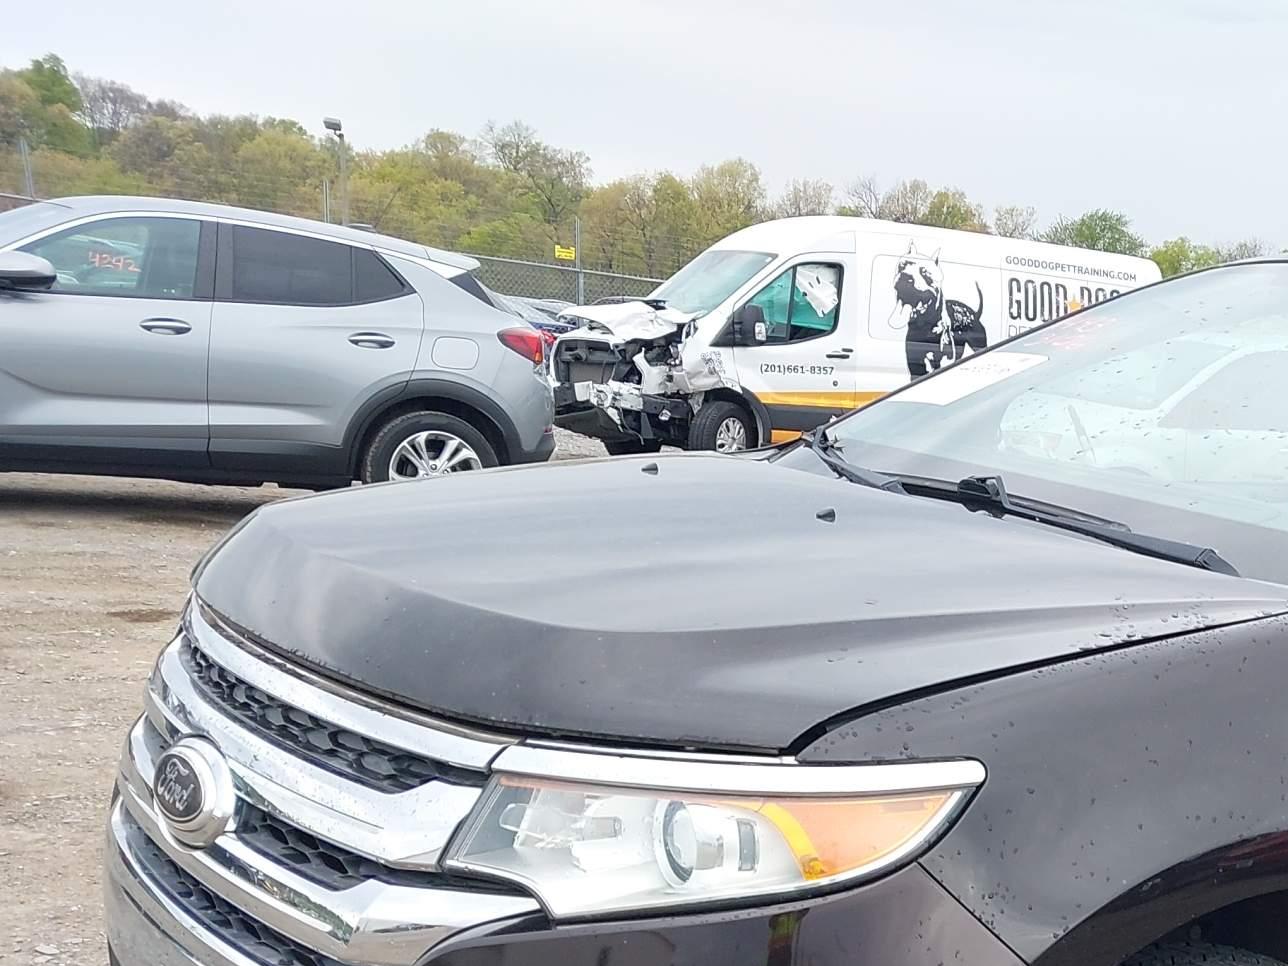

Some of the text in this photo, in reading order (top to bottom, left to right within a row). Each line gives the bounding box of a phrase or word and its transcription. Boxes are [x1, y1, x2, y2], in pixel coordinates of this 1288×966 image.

[88, 251, 142, 272] 4292
[1005, 255, 1137, 282] GOODDOGPETTRAINING.COM
[1007, 277, 1068, 323] GOOD
[759, 363, 834, 376] (201)661-8357
[157, 757, 195, 812] Ford
